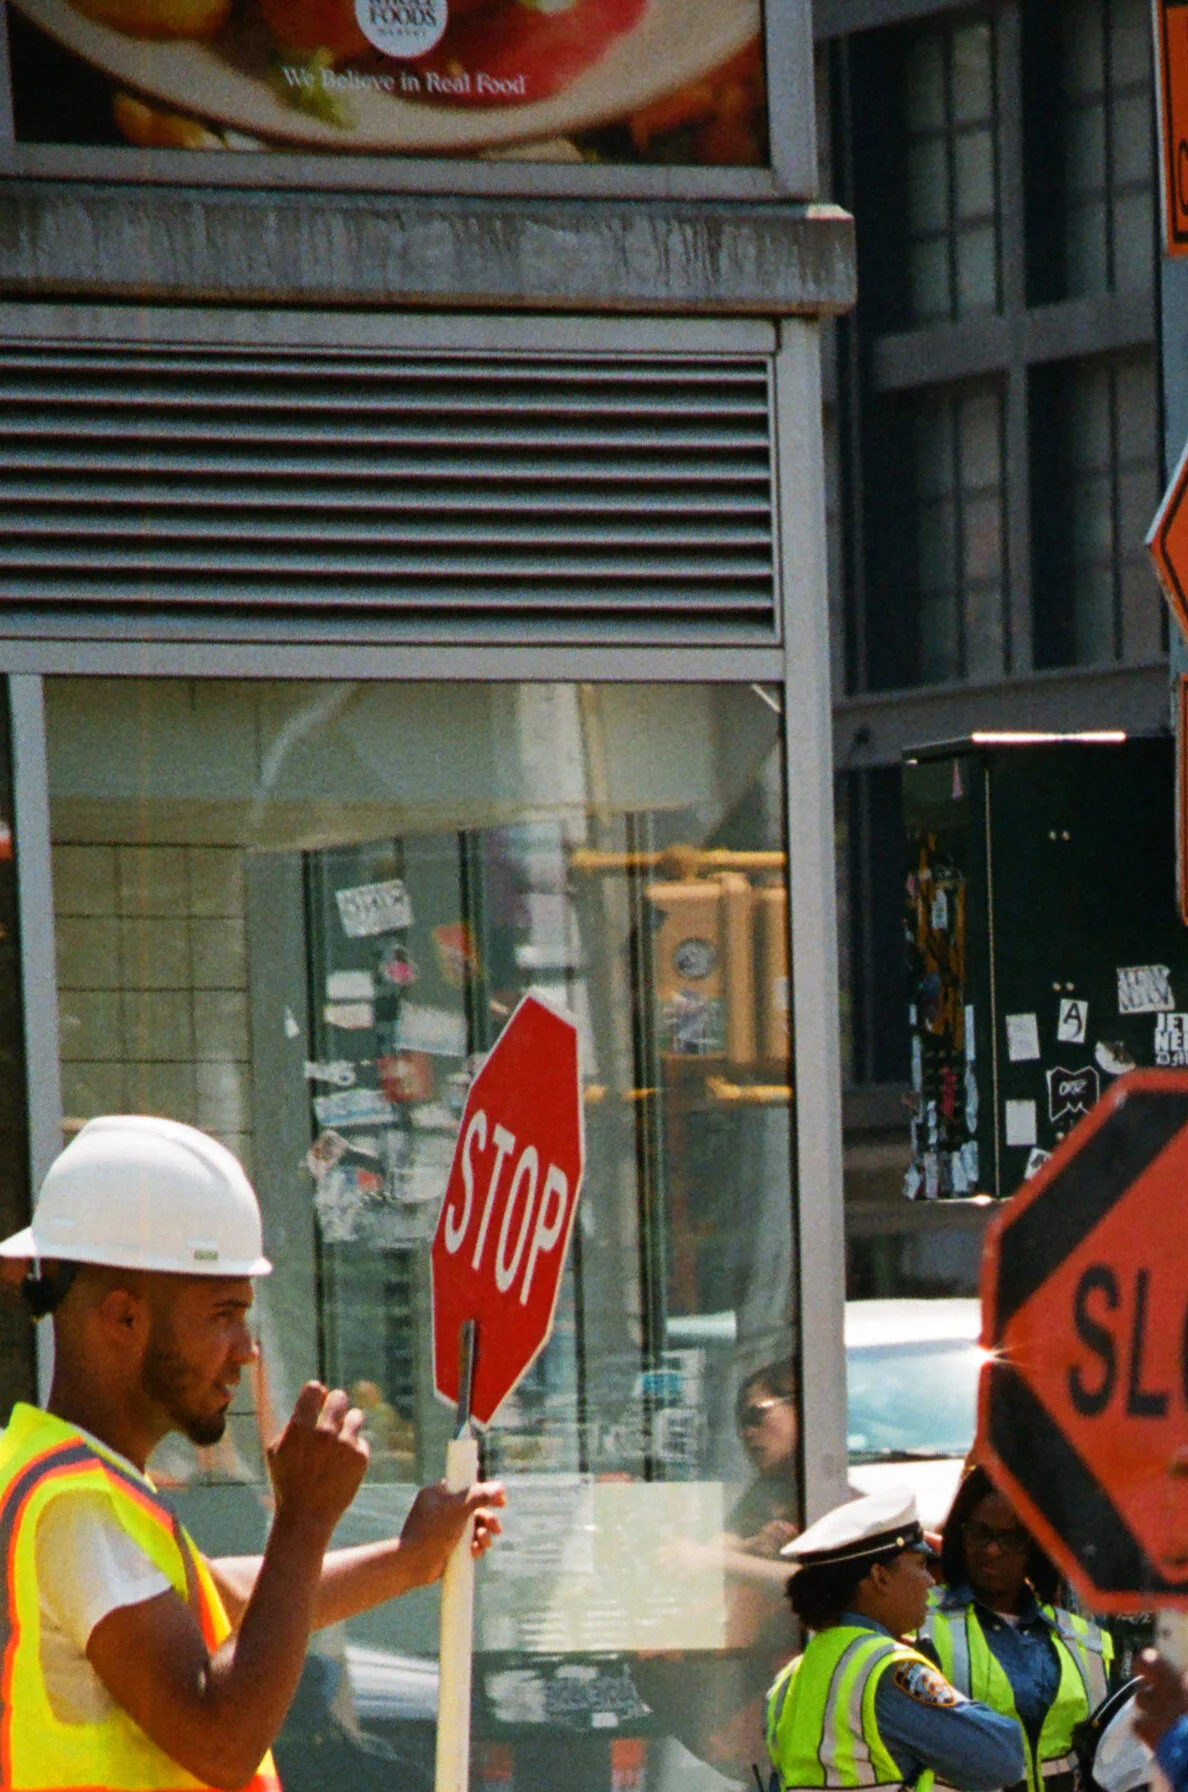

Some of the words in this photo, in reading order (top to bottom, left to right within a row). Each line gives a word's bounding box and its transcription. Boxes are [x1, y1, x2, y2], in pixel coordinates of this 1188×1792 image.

[282, 66, 315, 87] We
[321, 67, 394, 92] Believe
[401, 71, 421, 92] in
[424, 72, 470, 93] Real
[476, 72, 527, 95] Food
[445, 1109, 568, 1305] STOP
